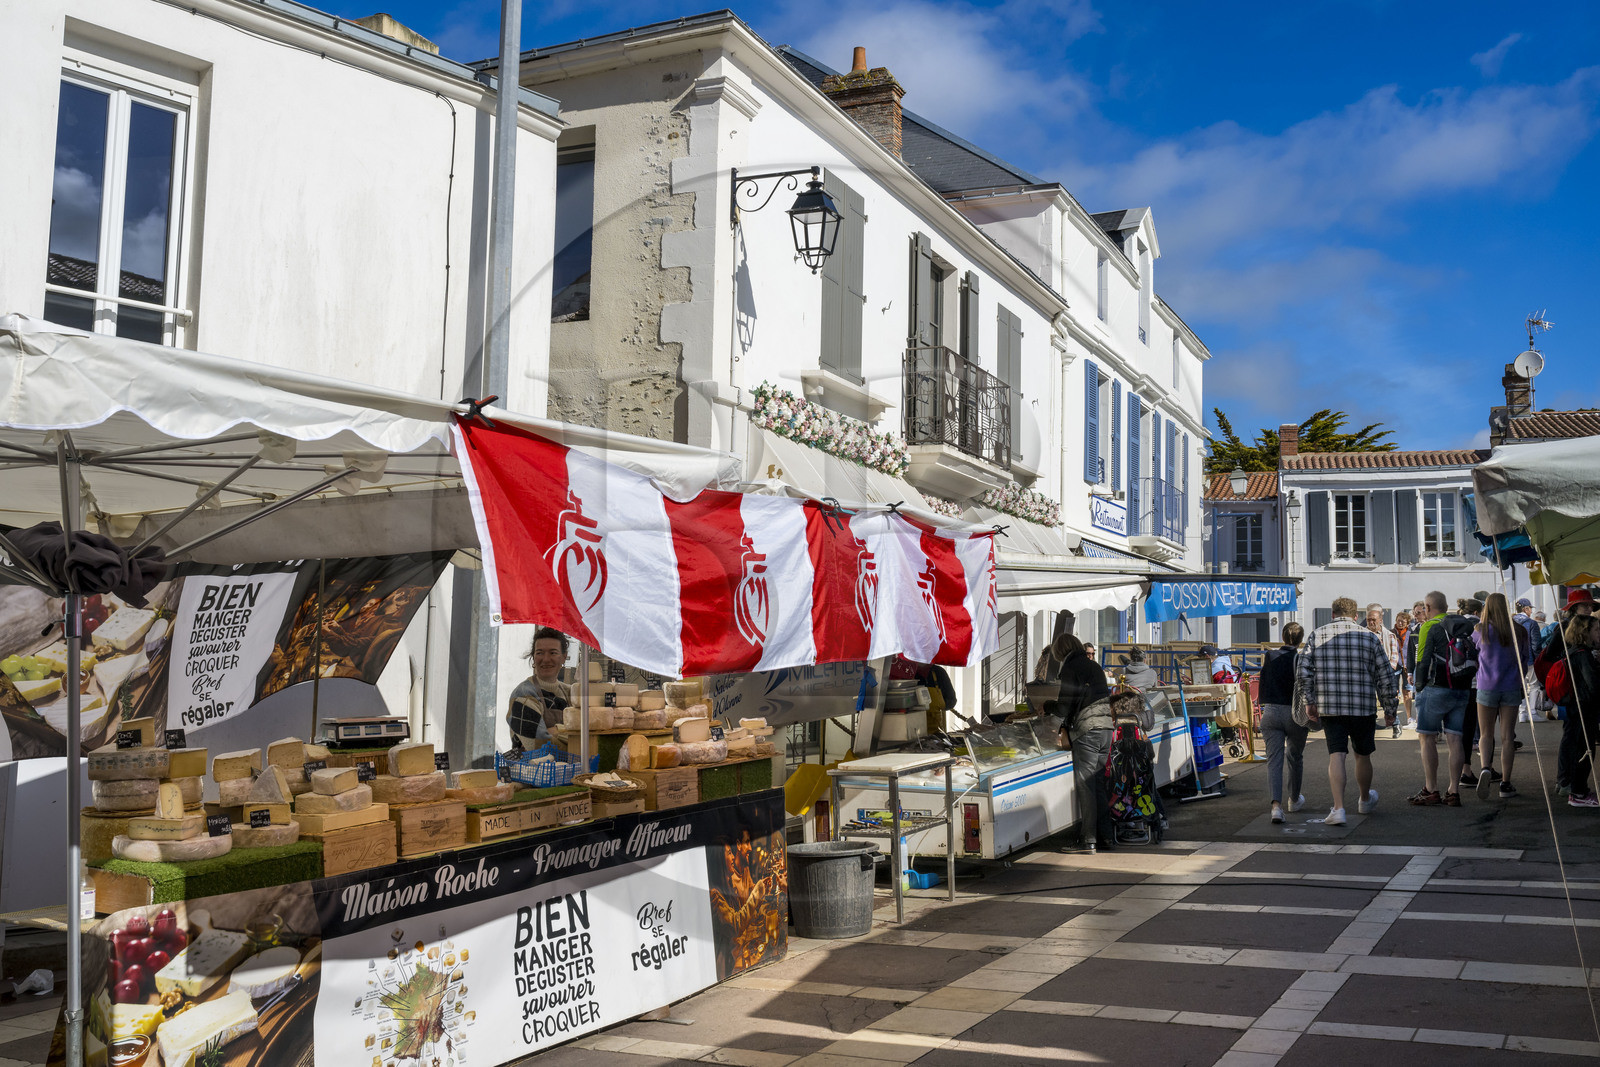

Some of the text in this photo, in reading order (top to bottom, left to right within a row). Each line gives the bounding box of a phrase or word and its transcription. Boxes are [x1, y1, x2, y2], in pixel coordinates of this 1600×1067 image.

[1094, 500, 1125, 531] Restaurant
[197, 582, 263, 612] BIEN
[193, 609, 252, 629] MANGER
[188, 639, 241, 660] savourer
[190, 625, 246, 644] DEGUSTER
[185, 655, 240, 677] CROQUER
[192, 674, 225, 695] Bref
[199, 692, 212, 702] SE
[181, 700, 234, 726] régaler
[485, 816, 510, 831] MADE
[557, 800, 589, 819] VENDÉE
[342, 879, 429, 922] Maison
[434, 857, 499, 899] Roche
[533, 838, 621, 875] Fromager
[626, 821, 692, 858] Affineur
[514, 890, 590, 949] BIEN
[637, 900, 673, 930] Bref
[652, 925, 665, 938] SE
[514, 932, 593, 975] MANGER
[631, 935, 688, 971] régaler
[515, 956, 596, 997] DEGUSTER
[522, 978, 596, 1020] savourer
[522, 1001, 600, 1044] CROQUER
